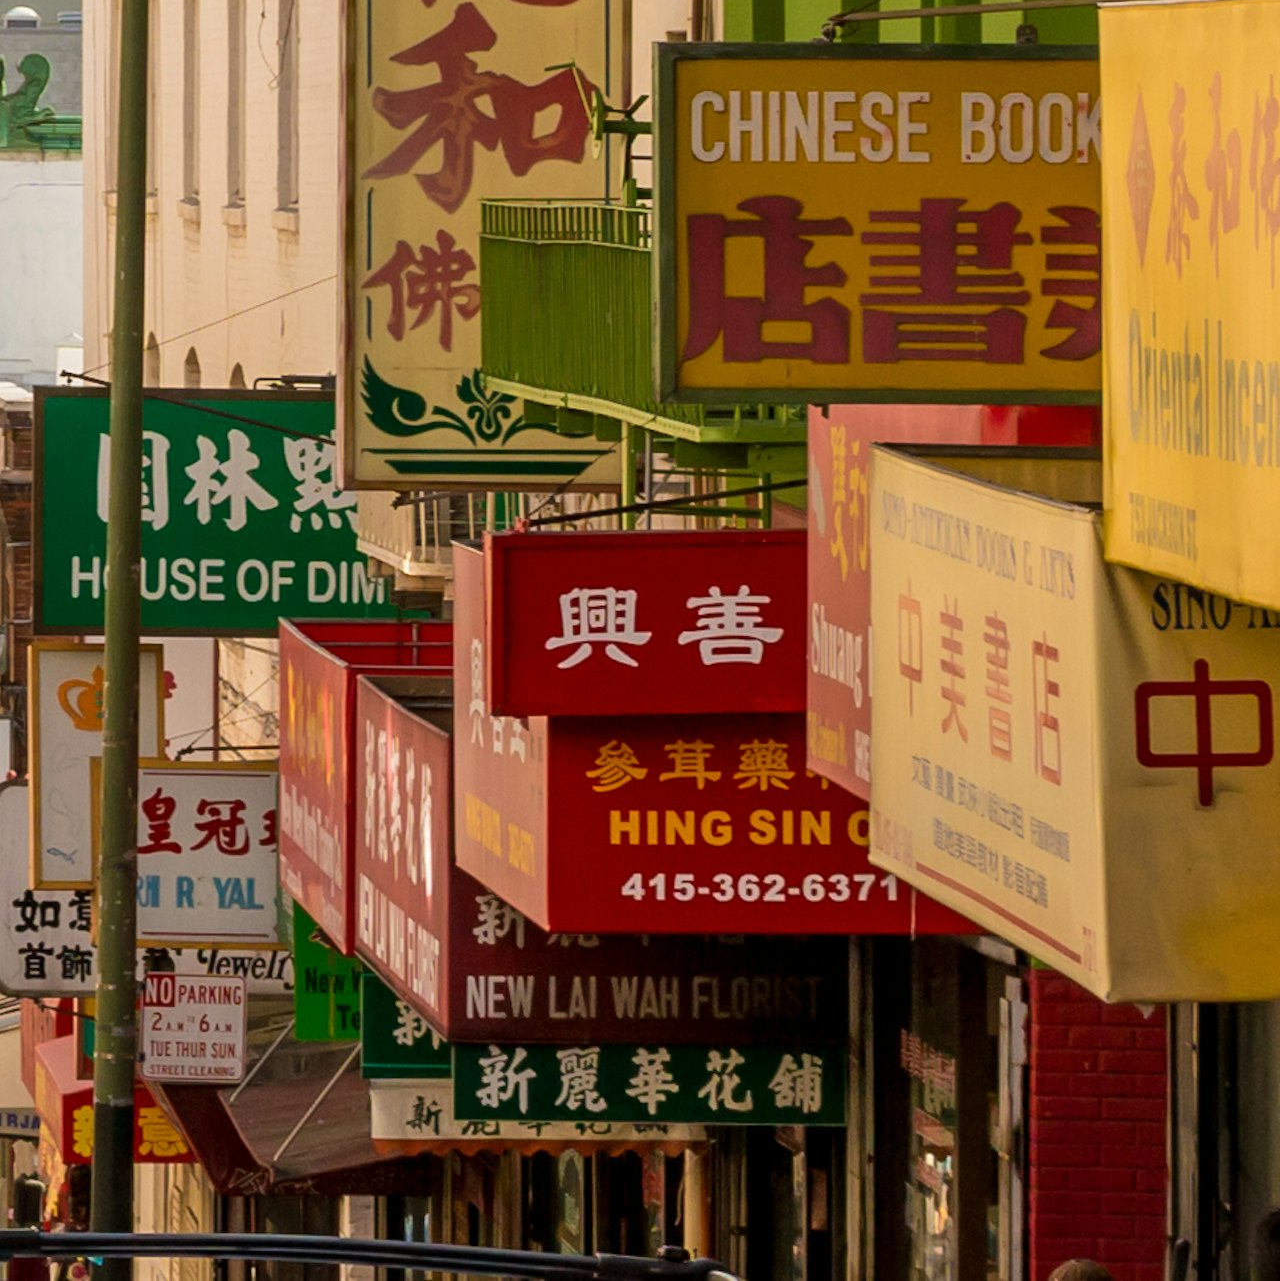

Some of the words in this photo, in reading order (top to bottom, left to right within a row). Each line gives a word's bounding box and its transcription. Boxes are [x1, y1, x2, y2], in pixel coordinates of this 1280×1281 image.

[691, 91, 931, 164] CHINESE
[1127, 306, 1210, 459] Oriental
[70, 555, 226, 602] HUSE
[236, 559, 295, 603] OF
[306, 561, 384, 605] DIM
[811, 603, 863, 708] Shuang
[1135, 658, 1274, 808] 中
[585, 739, 832, 792] 參茸藥
[610, 810, 734, 848] HING
[749, 810, 832, 848] SIN
[622, 874, 899, 903] 415-362-6371
[145, 976, 174, 1005] NO
[178, 983, 242, 1006] PARKING
[466, 976, 535, 1019] NEW
[548, 977, 598, 1019] LAI
[611, 977, 680, 1020] WAH
[691, 977, 823, 1020] FLORIST
[151, 1012, 163, 1032] 2
[199, 1013, 210, 1033] 6
[149, 1064, 185, 1076] STREET
[187, 1065, 235, 1077] CLEANING
[150, 1040, 171, 1058] TUE
[175, 1041, 206, 1059] THUR
